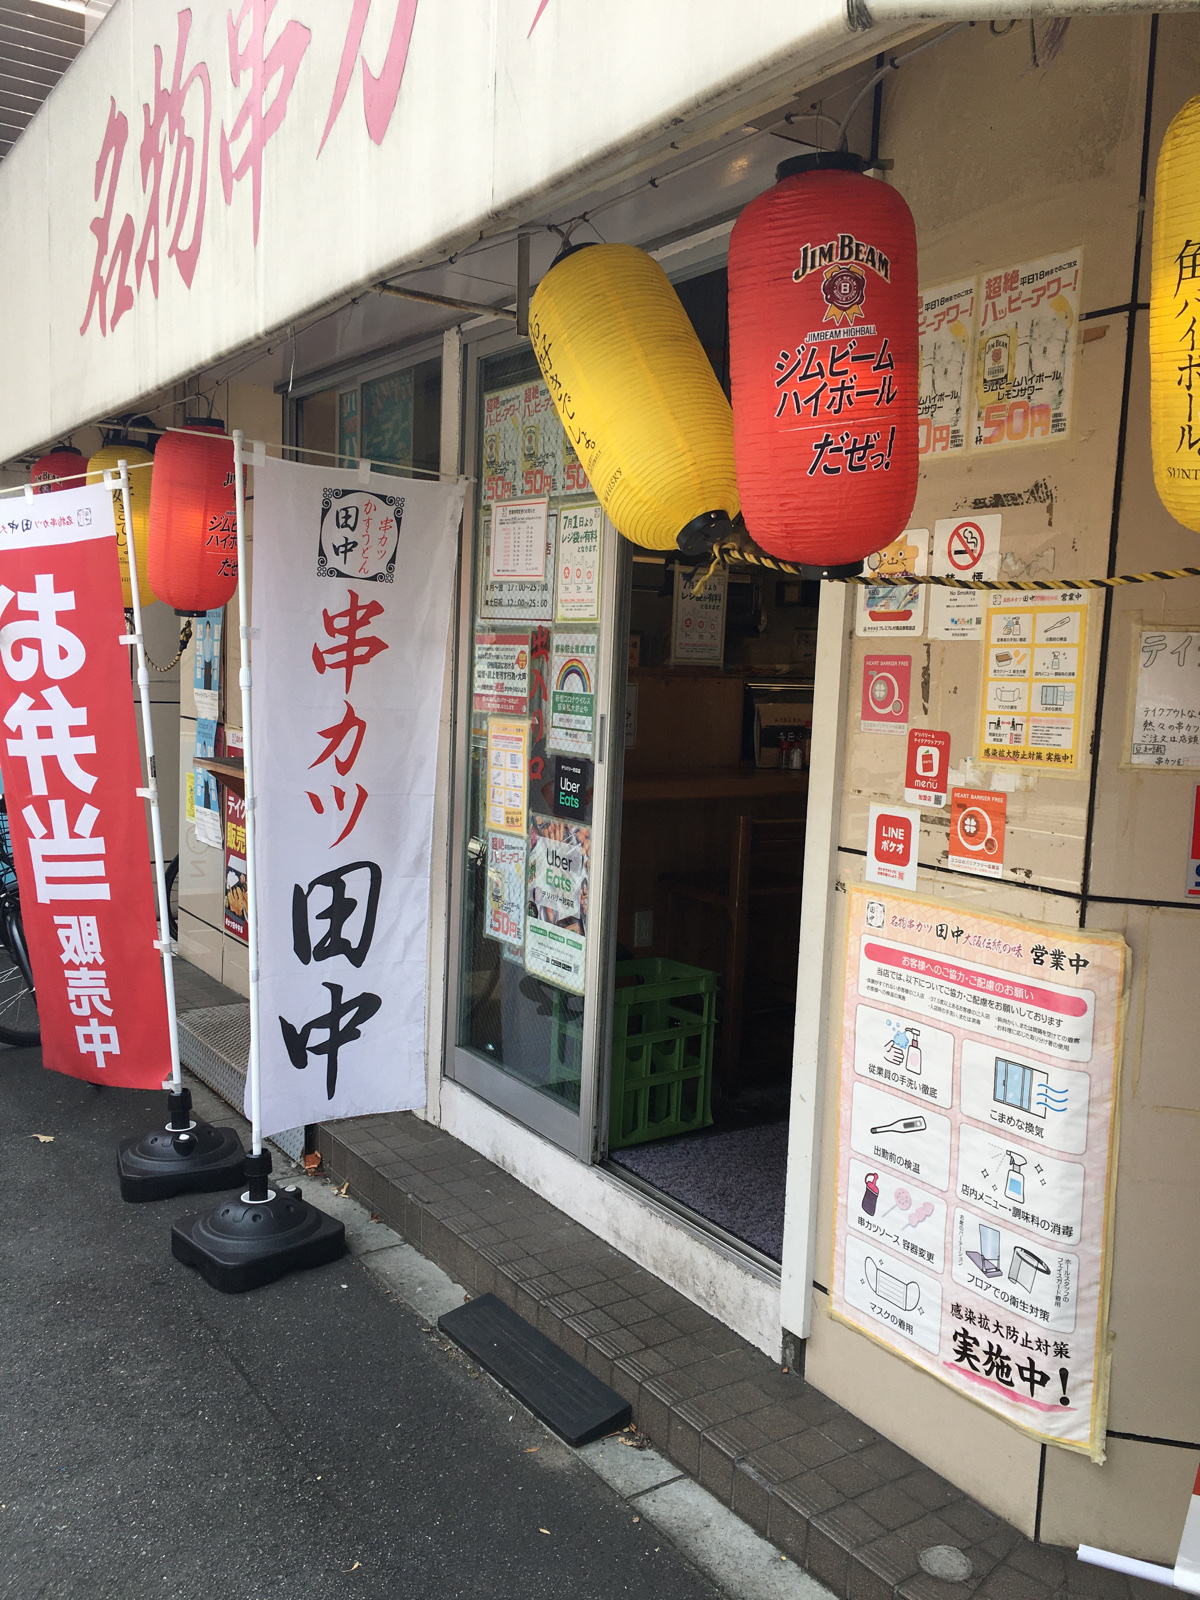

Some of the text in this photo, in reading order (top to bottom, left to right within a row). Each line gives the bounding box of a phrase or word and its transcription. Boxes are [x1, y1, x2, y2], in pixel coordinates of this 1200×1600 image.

[793, 233, 891, 284] JIM BEAM
[985, 269, 1019, 301] 超絶
[805, 325, 877, 343] JIMBEAM HIGHBALL
[775, 338, 896, 388] ジムビーム
[774, 374, 898, 418] ハイボール
[997, 386, 1043, 402] レモンサワー
[982, 400, 1051, 444] 50円
[486, 476, 512, 500] 50円
[525, 469, 552, 495] 50円
[332, 506, 360, 565] 田中
[562, 529, 598, 544] レジ袋が有料
[563, 514, 593, 530] 7月1日より
[358, 499, 377, 575] かすうどん
[377, 517, 394, 560] 串カツ
[1061, 592, 1082, 602] 営業中
[914, 738, 945, 746] テイクアウトアプリ
[983, 748, 1074, 764] 感染拡大防止対策 実施中!
[1135, 745, 1164, 754] 豆知識
[560, 776, 580, 794] Uber
[914, 779, 938, 789] menu
[970, 794, 990, 802] BARRIER
[559, 791, 579, 809] Eats
[277, 588, 390, 1101] 串カツ田中
[881, 840, 904, 855] ポケオ
[882, 826, 905, 840] LINE
[546, 847, 572, 872] Uber
[545, 868, 572, 893] Eats
[493, 909, 518, 938] 50円
[1030, 944, 1090, 975] 営業中
[902, 956, 1035, 1001] お客様へのご協力・ご配慮のお願い
[868, 1062, 938, 1099] 従業員の手洗い徹底
[990, 1110, 1045, 1139] こまめな換気
[873, 1145, 921, 1174] 出勤前の検温
[961, 1184, 1075, 1238] 店内メニュー・調味料の消毒
[858, 1215, 936, 1265] 串カツソース 容器変更
[966, 1272, 1051, 1323] フロアでの衛生対策
[868, 1301, 914, 1336] マスクの着用
[950, 1303, 1072, 1359] 感染拡大防止対策
[952, 1326, 1073, 1407] 実施中!
